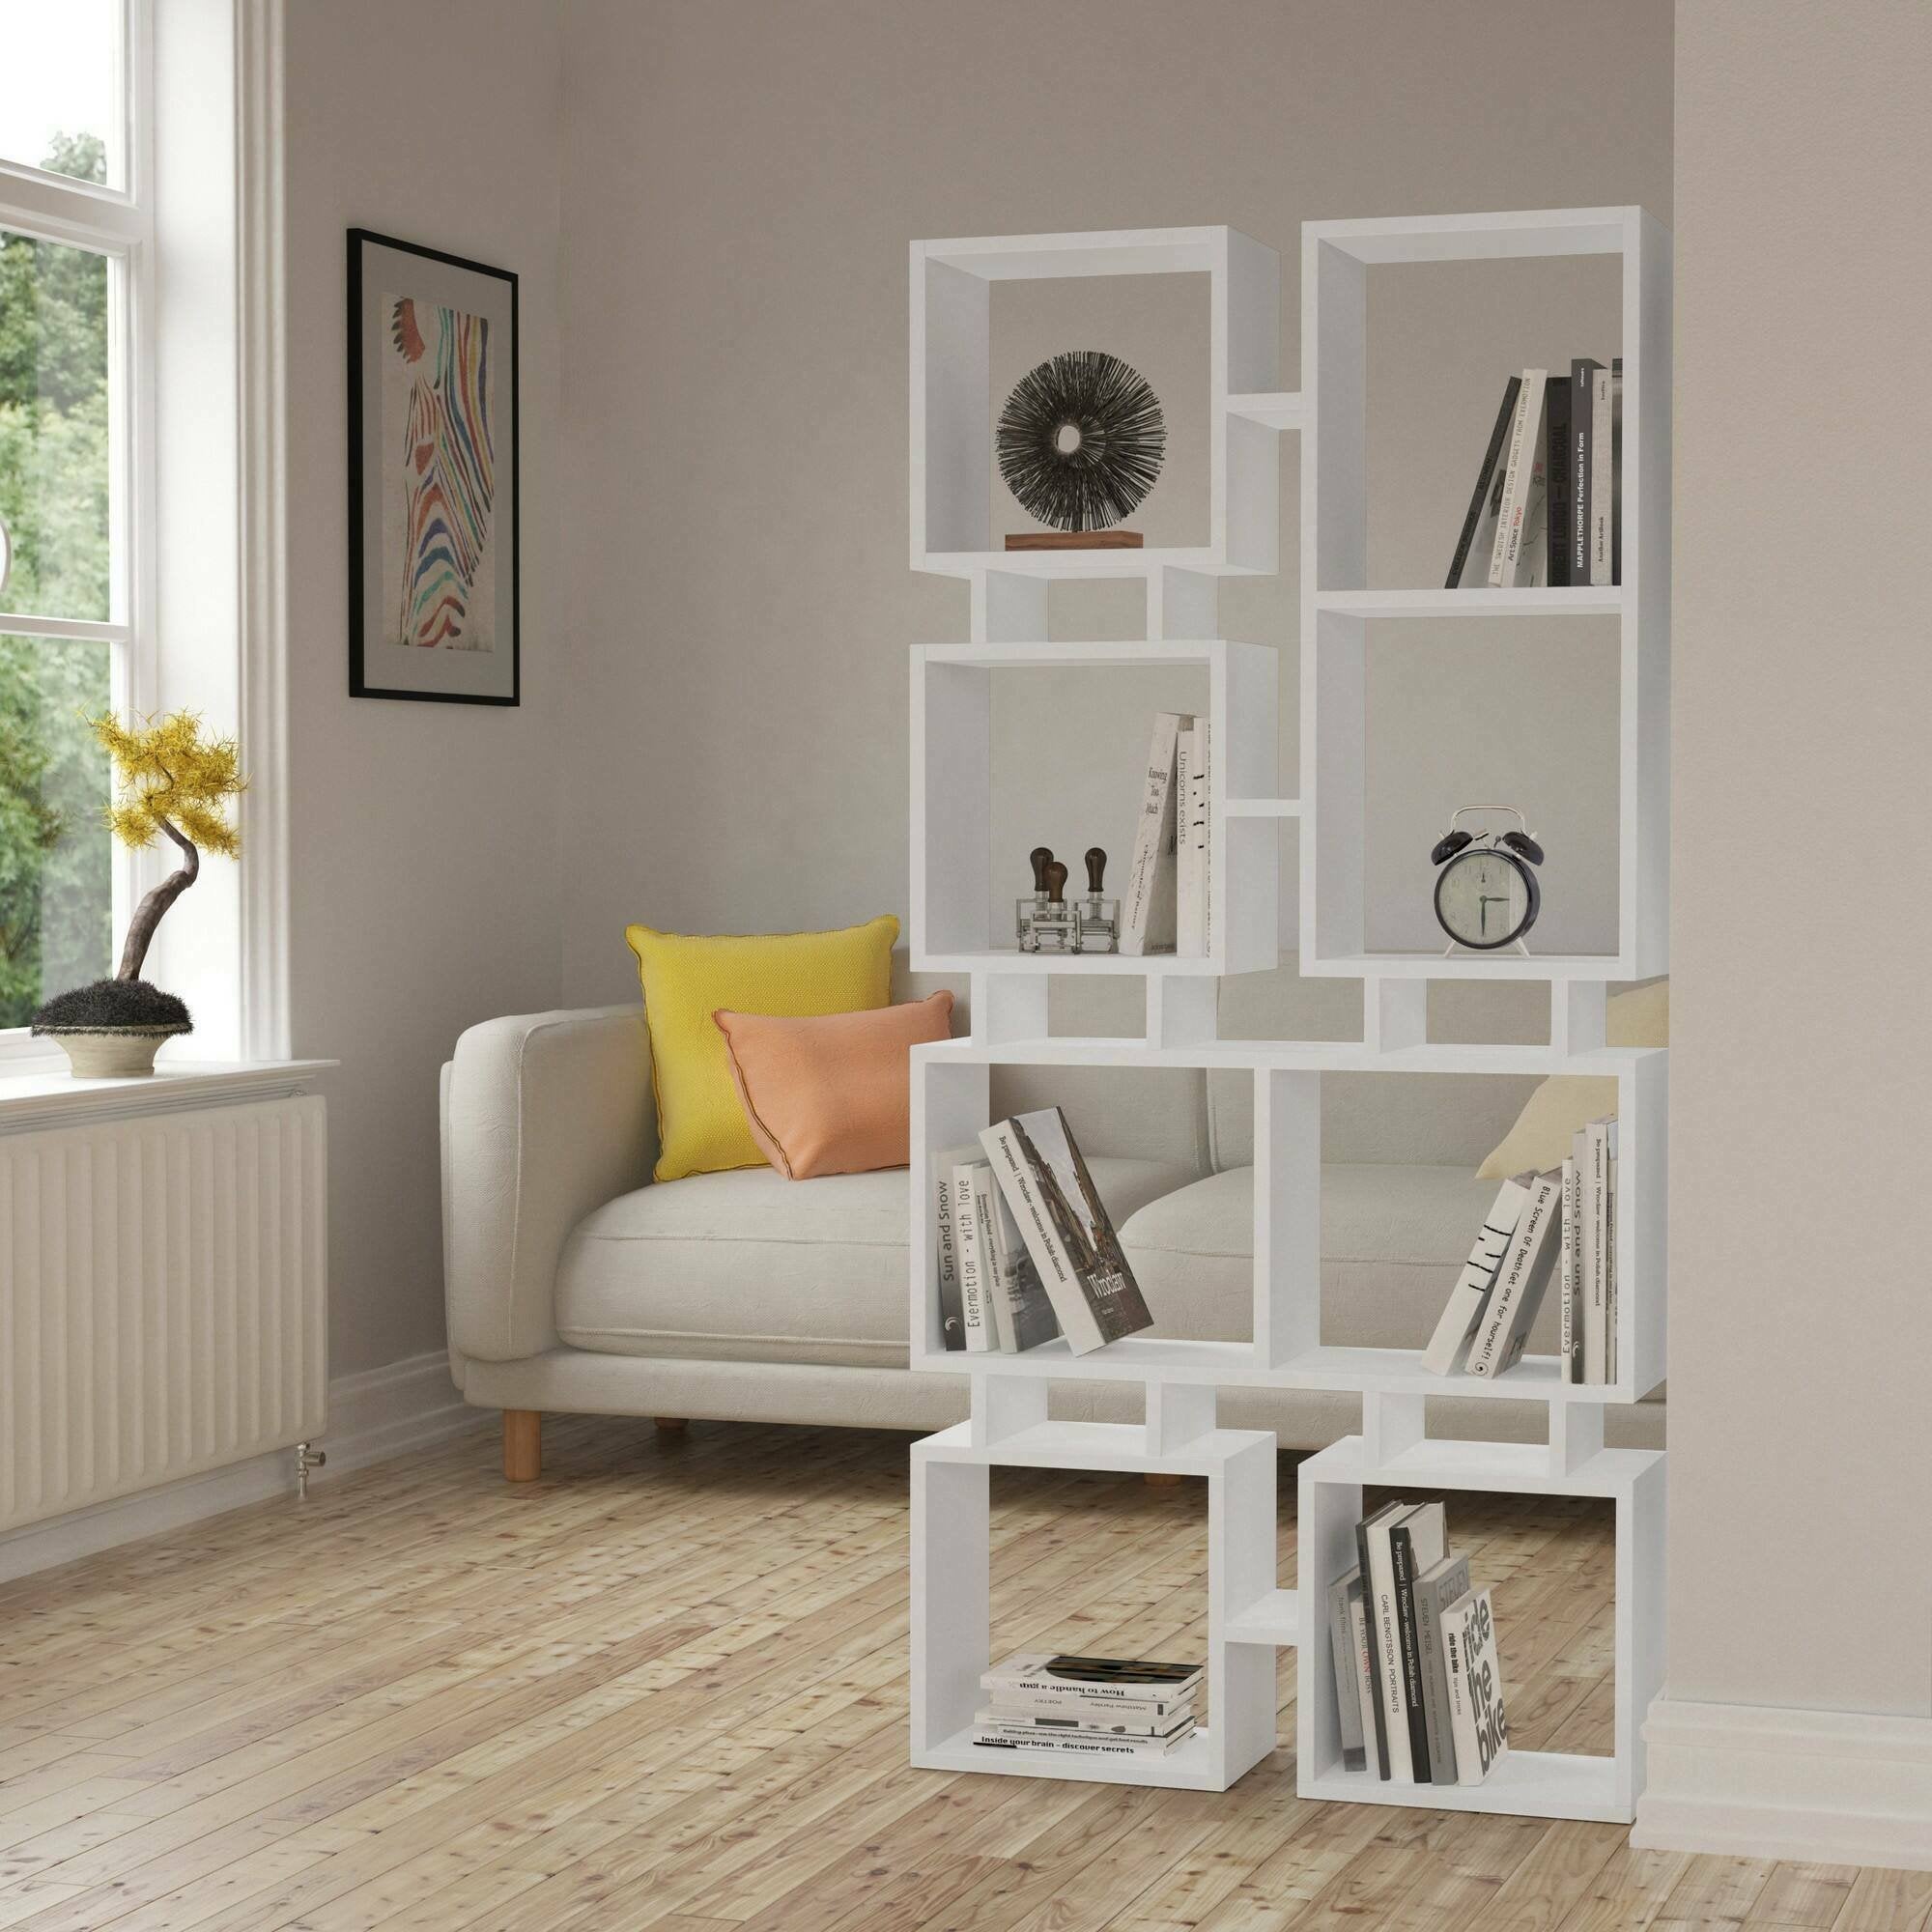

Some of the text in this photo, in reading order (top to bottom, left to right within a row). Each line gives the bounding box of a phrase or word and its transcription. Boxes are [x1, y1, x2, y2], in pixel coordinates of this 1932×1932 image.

[1513, 506, 1522, 526] Tokyo
[1179, 751, 1187, 845] Unicorns exists
[957, 1180, 970, 1207] love
[1537, 1185, 1550, 1205] Blue
[1561, 1178, 1571, 1208] love
[938, 1181, 954, 1282] Sun and Snow
[958, 1214, 973, 1241] with
[1527, 1207, 1543, 1234] Screen
[1561, 1218, 1571, 1250] with
[1523, 1236, 1532, 1247] Of
[964, 1261, 980, 1327] Evermotion
[1501, 1288, 1512, 1302] one
[1497, 1305, 1508, 1319] for
[1561, 1274, 1572, 1353] Evermotion
[1395, 1550, 1406, 1580] prepared
[1380, 1594, 1400, 1713] CARL BENGTSSON PORTRAITS
[1049, 1686, 1085, 1694] handle
[1475, 1698, 1508, 1777] bike
